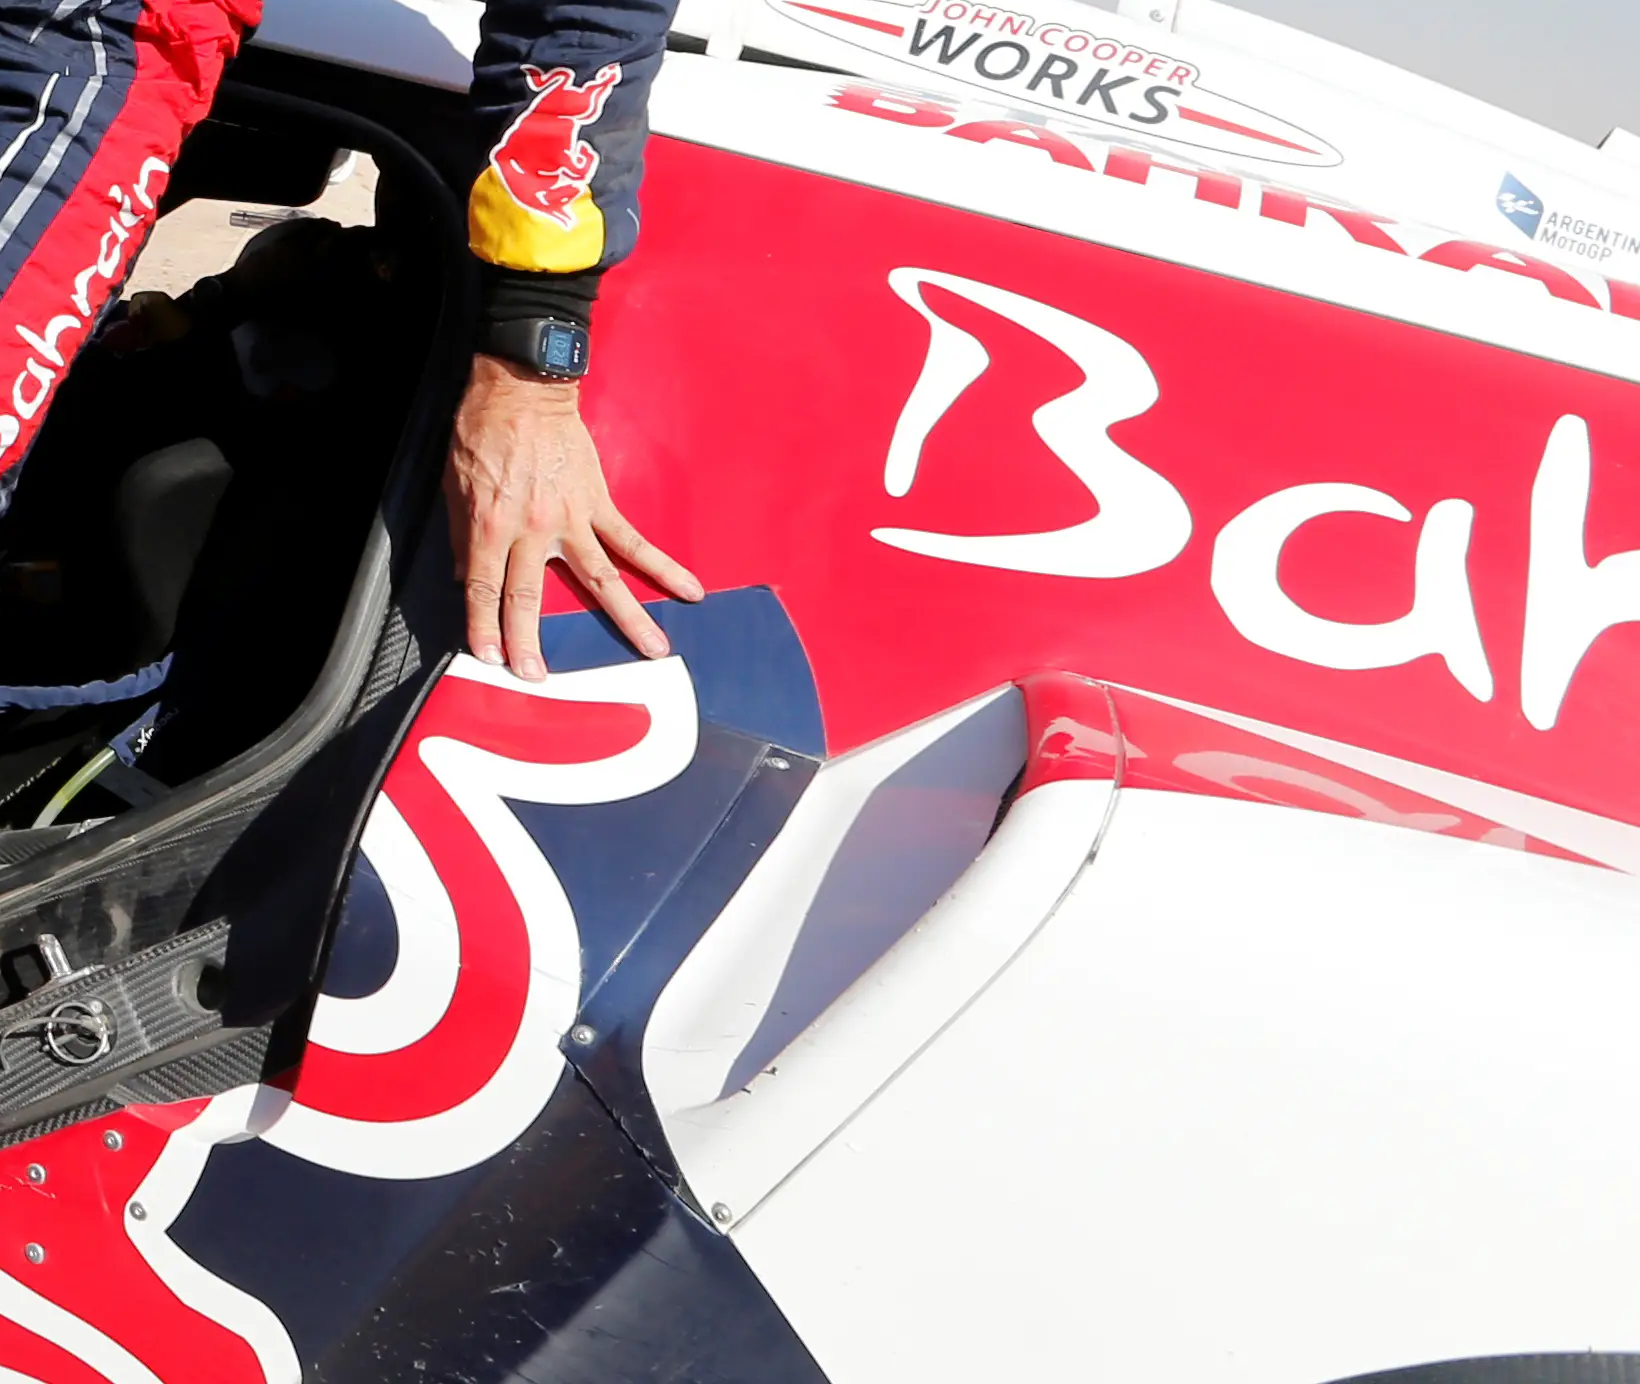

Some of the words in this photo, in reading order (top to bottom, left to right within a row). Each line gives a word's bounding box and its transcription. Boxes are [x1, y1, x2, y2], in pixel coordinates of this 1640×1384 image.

[908, 18, 1182, 124] WORKS
[921, 0, 1028, 35] JOHN
[1039, 27, 1193, 85] COOPER
